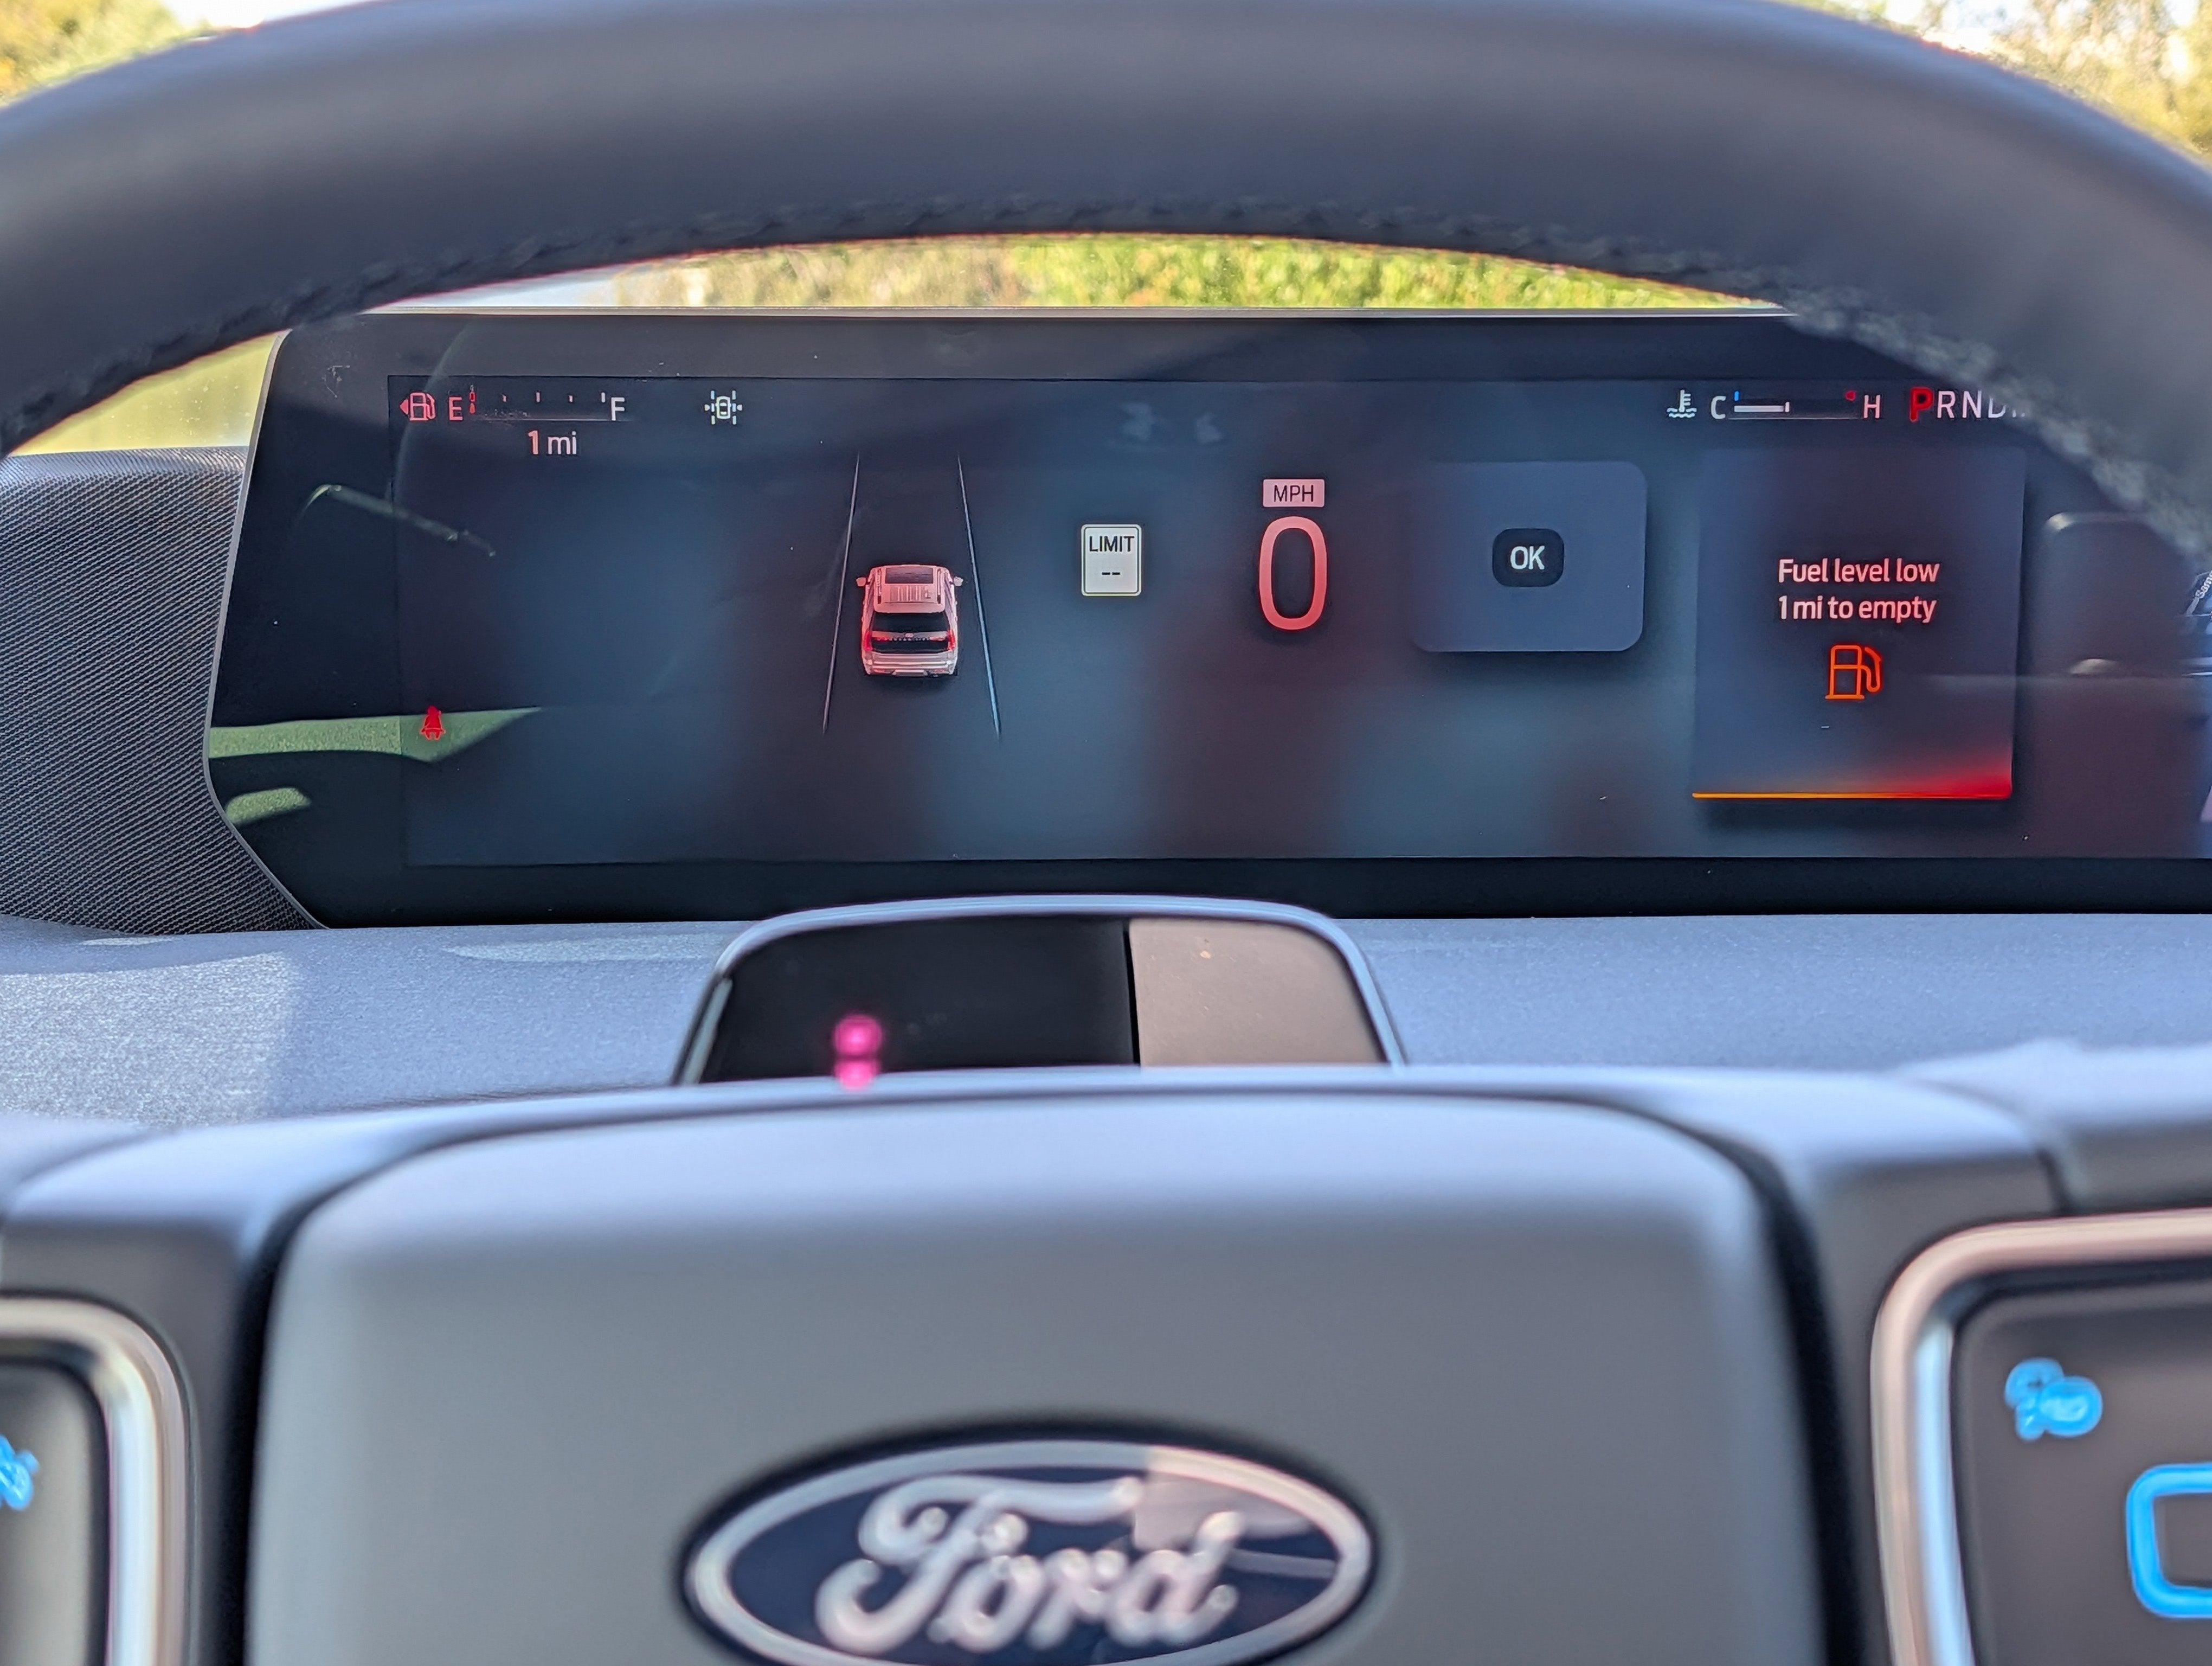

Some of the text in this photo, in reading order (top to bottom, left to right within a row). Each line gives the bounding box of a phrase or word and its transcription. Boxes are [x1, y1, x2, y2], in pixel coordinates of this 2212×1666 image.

[448, 396, 625, 420] E F
[1711, 394, 1881, 420] C H
[1909, 386, 2025, 423] PRND
[528, 430, 577, 454] 1 mi
[1274, 484, 1314, 503] MPH
[1089, 535, 1134, 552] LIMIT
[1510, 545, 1545, 571] OK
[1778, 558, 1940, 583] Fuel level low
[1259, 516, 1327, 630] 0
[1778, 595, 1937, 623] 1 mi to empty
[814, 1475, 1242, 1654] Ford
